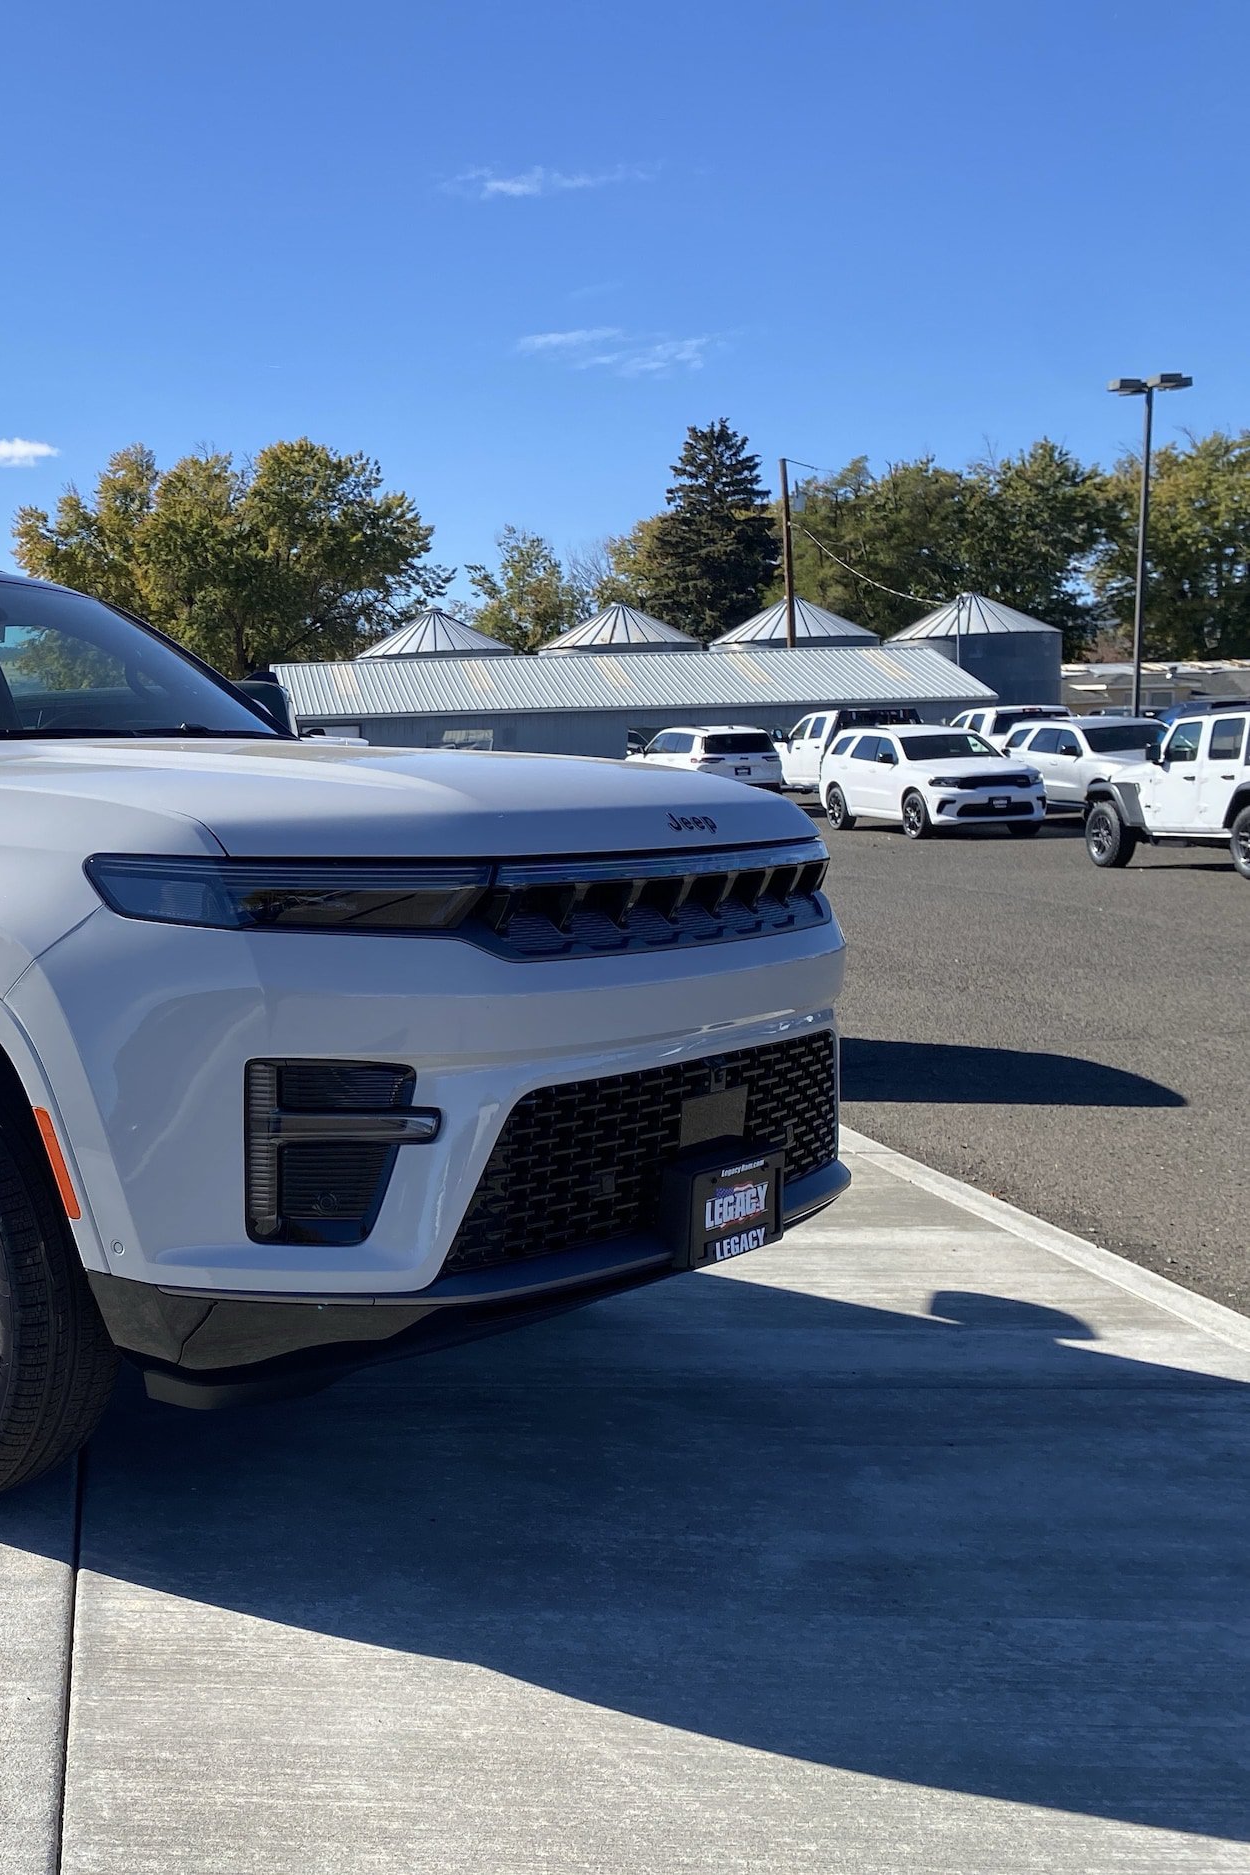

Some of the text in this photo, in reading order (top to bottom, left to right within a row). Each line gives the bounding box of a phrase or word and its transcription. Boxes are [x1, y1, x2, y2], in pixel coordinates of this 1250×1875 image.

[665, 812, 718, 834] Jeep
[705, 1183, 769, 1230] LEGACY
[715, 1227, 766, 1261] LEGACY
